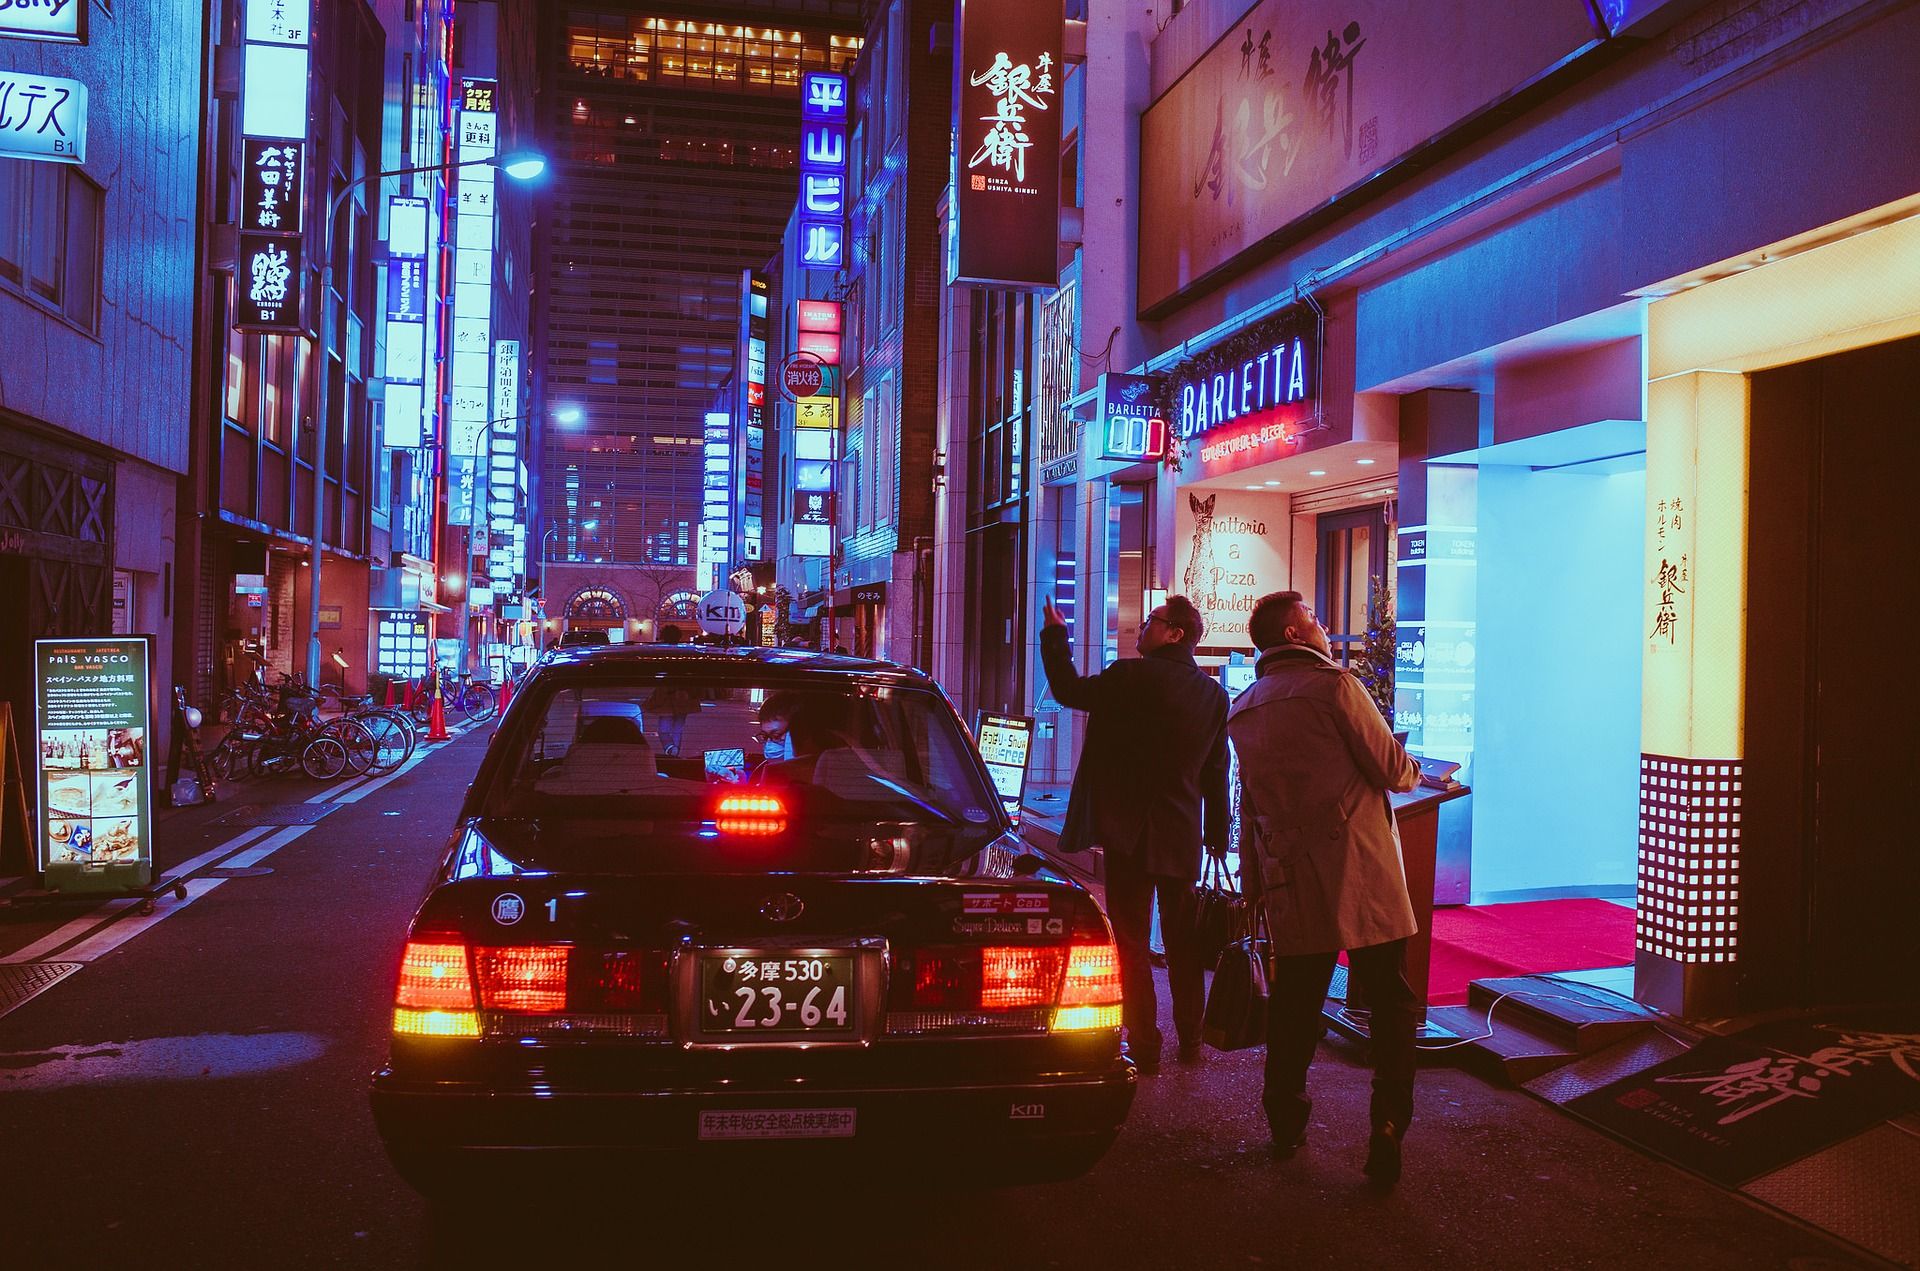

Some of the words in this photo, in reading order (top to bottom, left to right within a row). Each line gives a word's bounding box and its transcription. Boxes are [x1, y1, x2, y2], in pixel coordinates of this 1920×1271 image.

[288, 29, 302, 39] 3F
[466, 88, 492, 99] クラブ
[465, 98, 492, 112] 月光
[968, 51, 1048, 183] 銀兵衛
[53, 140, 74, 153] B1
[804, 76, 844, 261] 平山ビル
[255, 146, 282, 228] 広田美術
[987, 177, 1009, 185] GINZA
[987, 185, 1013, 193] USHIYA
[260, 309, 276, 321] B1
[787, 370, 820, 386] 消火栓
[1181, 336, 1305, 437] BARLETTA
[1108, 402, 1162, 418] BARLETTA
[1670, 497, 1683, 530] 焼肉
[1657, 500, 1667, 552] ホルモン
[1210, 567, 1258, 586] Pizza
[1650, 559, 1686, 645] 銀兵衛
[85, 655, 129, 664] VASCO
[497, 898, 520, 920] 鷹
[544, 898, 557, 922] 1
[971, 898, 1013, 909] サポート
[1016, 898, 1042, 908] Cab
[738, 960, 781, 982] 多摩
[785, 960, 823, 981] 530
[709, 999, 730, 1016] い
[735, 986, 847, 1027] 23-64
[1010, 1103, 1045, 1116] km
